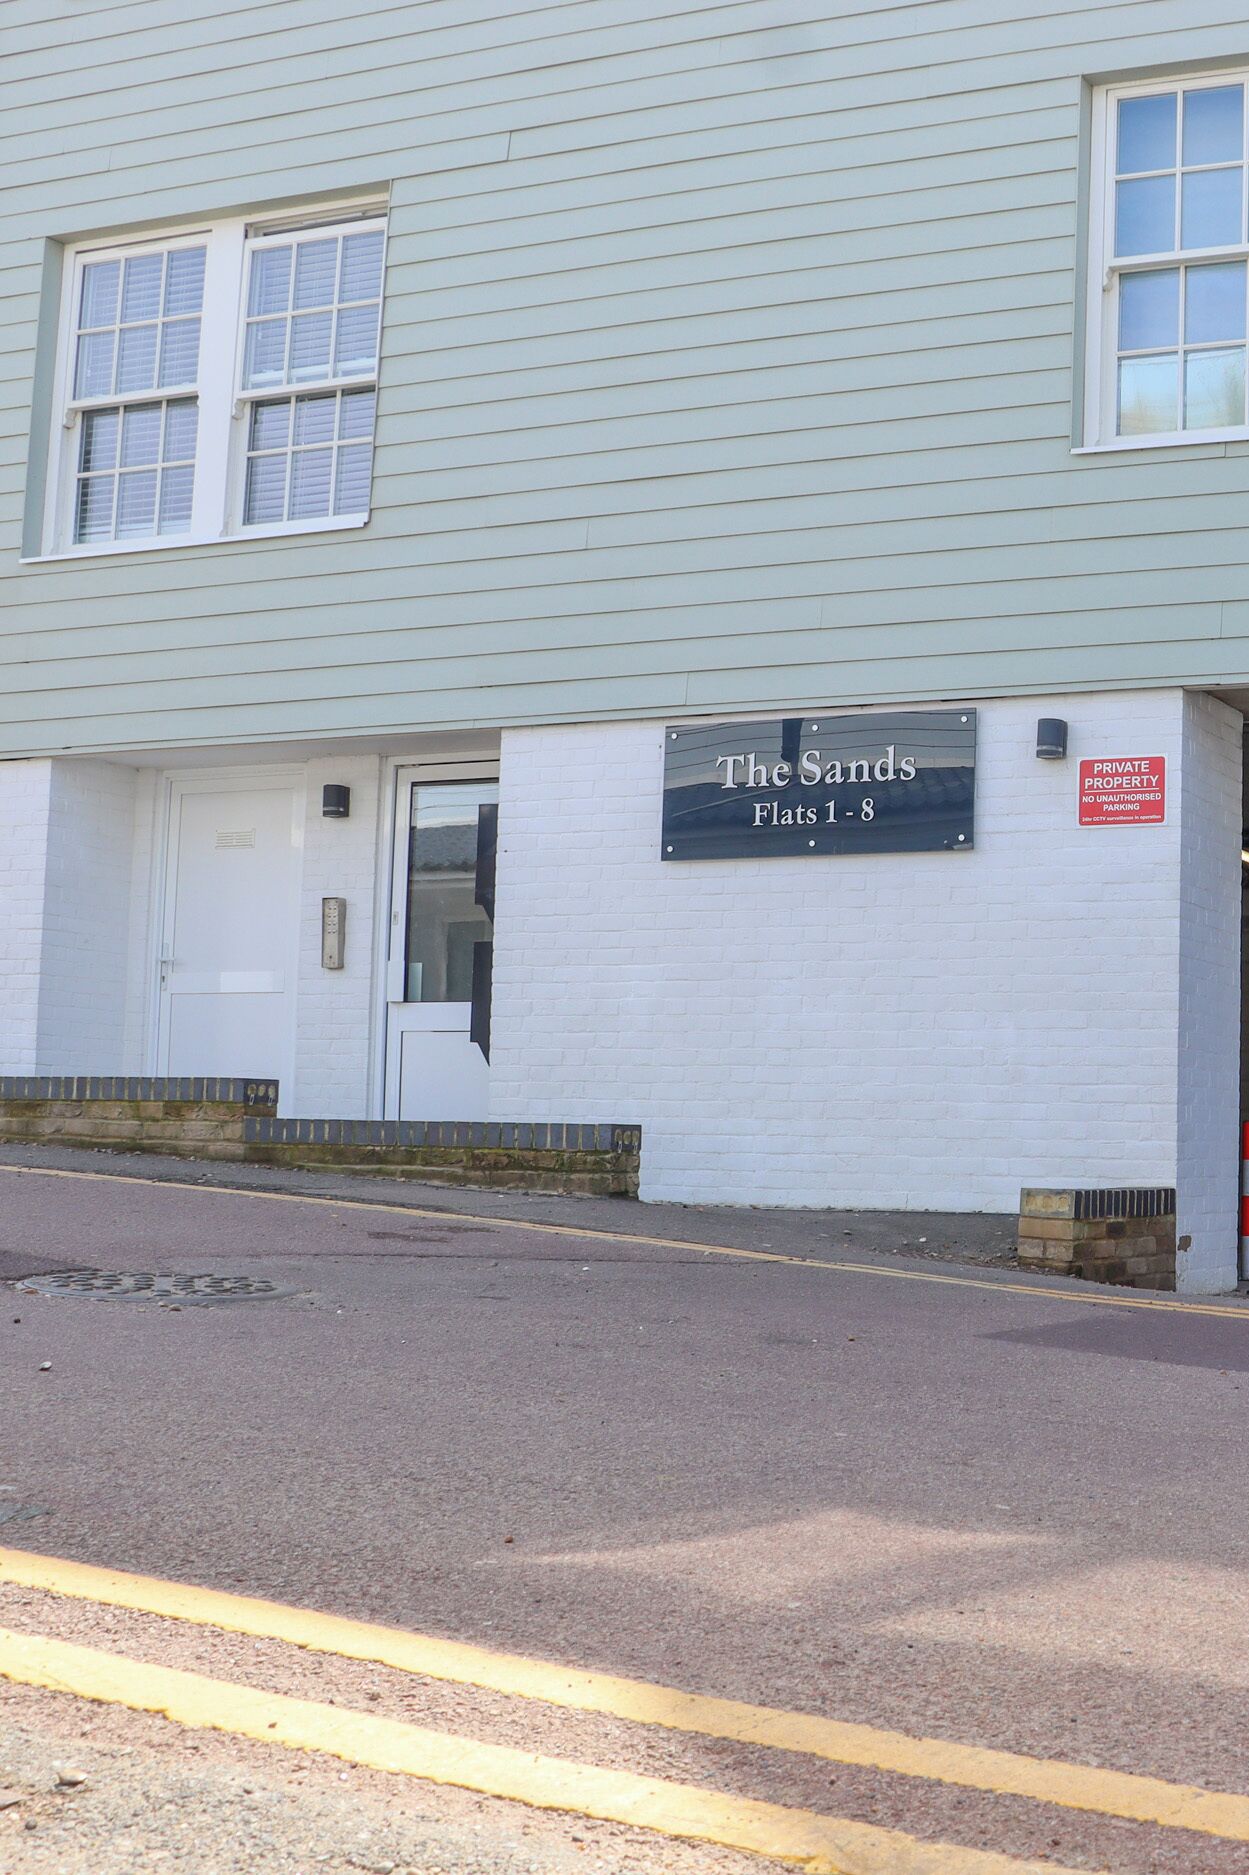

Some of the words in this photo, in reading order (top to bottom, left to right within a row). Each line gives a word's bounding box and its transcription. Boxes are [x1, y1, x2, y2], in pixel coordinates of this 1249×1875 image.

[716, 752, 791, 789] The
[800, 744, 917, 786] Sands
[1093, 760, 1150, 774] PRIVATE
[1084, 775, 1159, 789] PROPERTY
[1082, 795, 1095, 803] NO
[1096, 793, 1162, 802] UNAUTHORISED
[752, 801, 818, 826] Flats
[825, 800, 838, 823] 1
[861, 798, 875, 821] 8
[1103, 803, 1140, 811] PARKING
